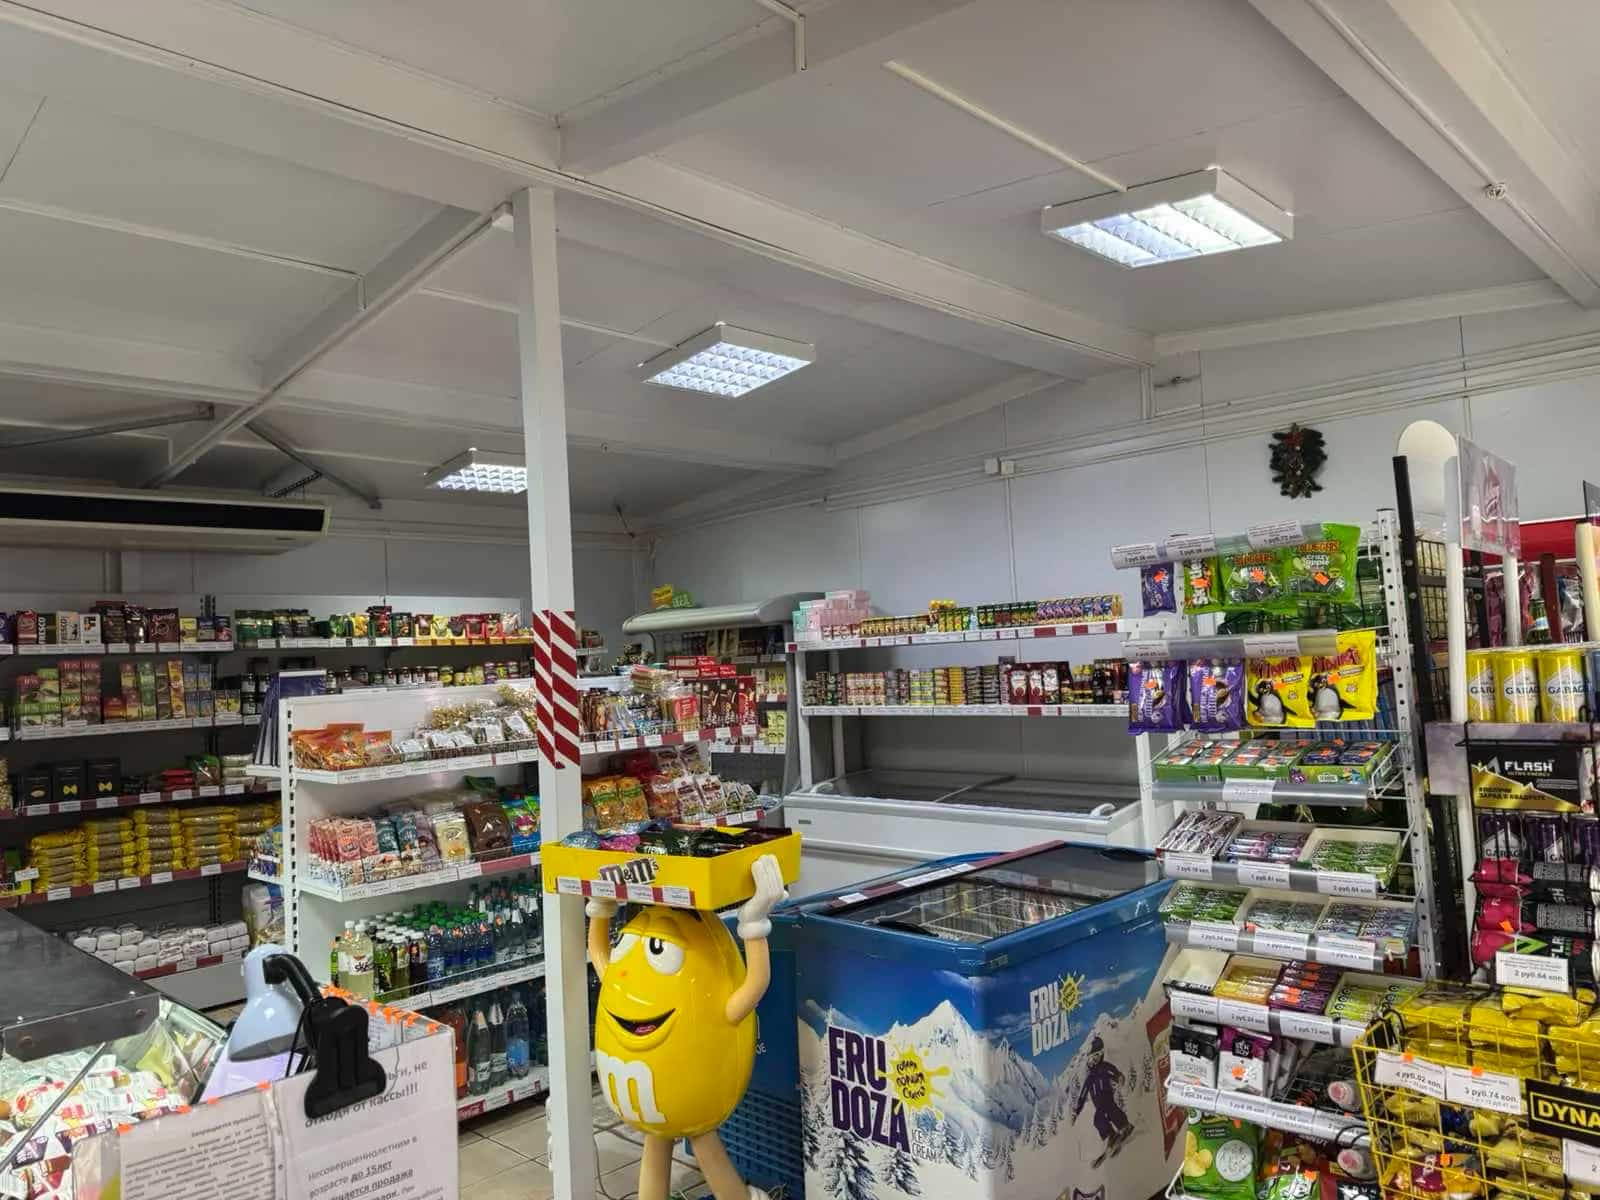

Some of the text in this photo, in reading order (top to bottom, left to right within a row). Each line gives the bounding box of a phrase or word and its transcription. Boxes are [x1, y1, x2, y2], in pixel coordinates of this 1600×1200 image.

[1504, 761, 1553, 772] FLASH
[1030, 981, 1059, 1023] FRU
[1032, 1008, 1070, 1056] DOZA
[414, 1061, 428, 1072] не
[828, 1025, 887, 1091] FRU
[352, 1100, 368, 1113] от
[830, 1077, 911, 1153] DOZA
[350, 1170, 364, 1183] до
